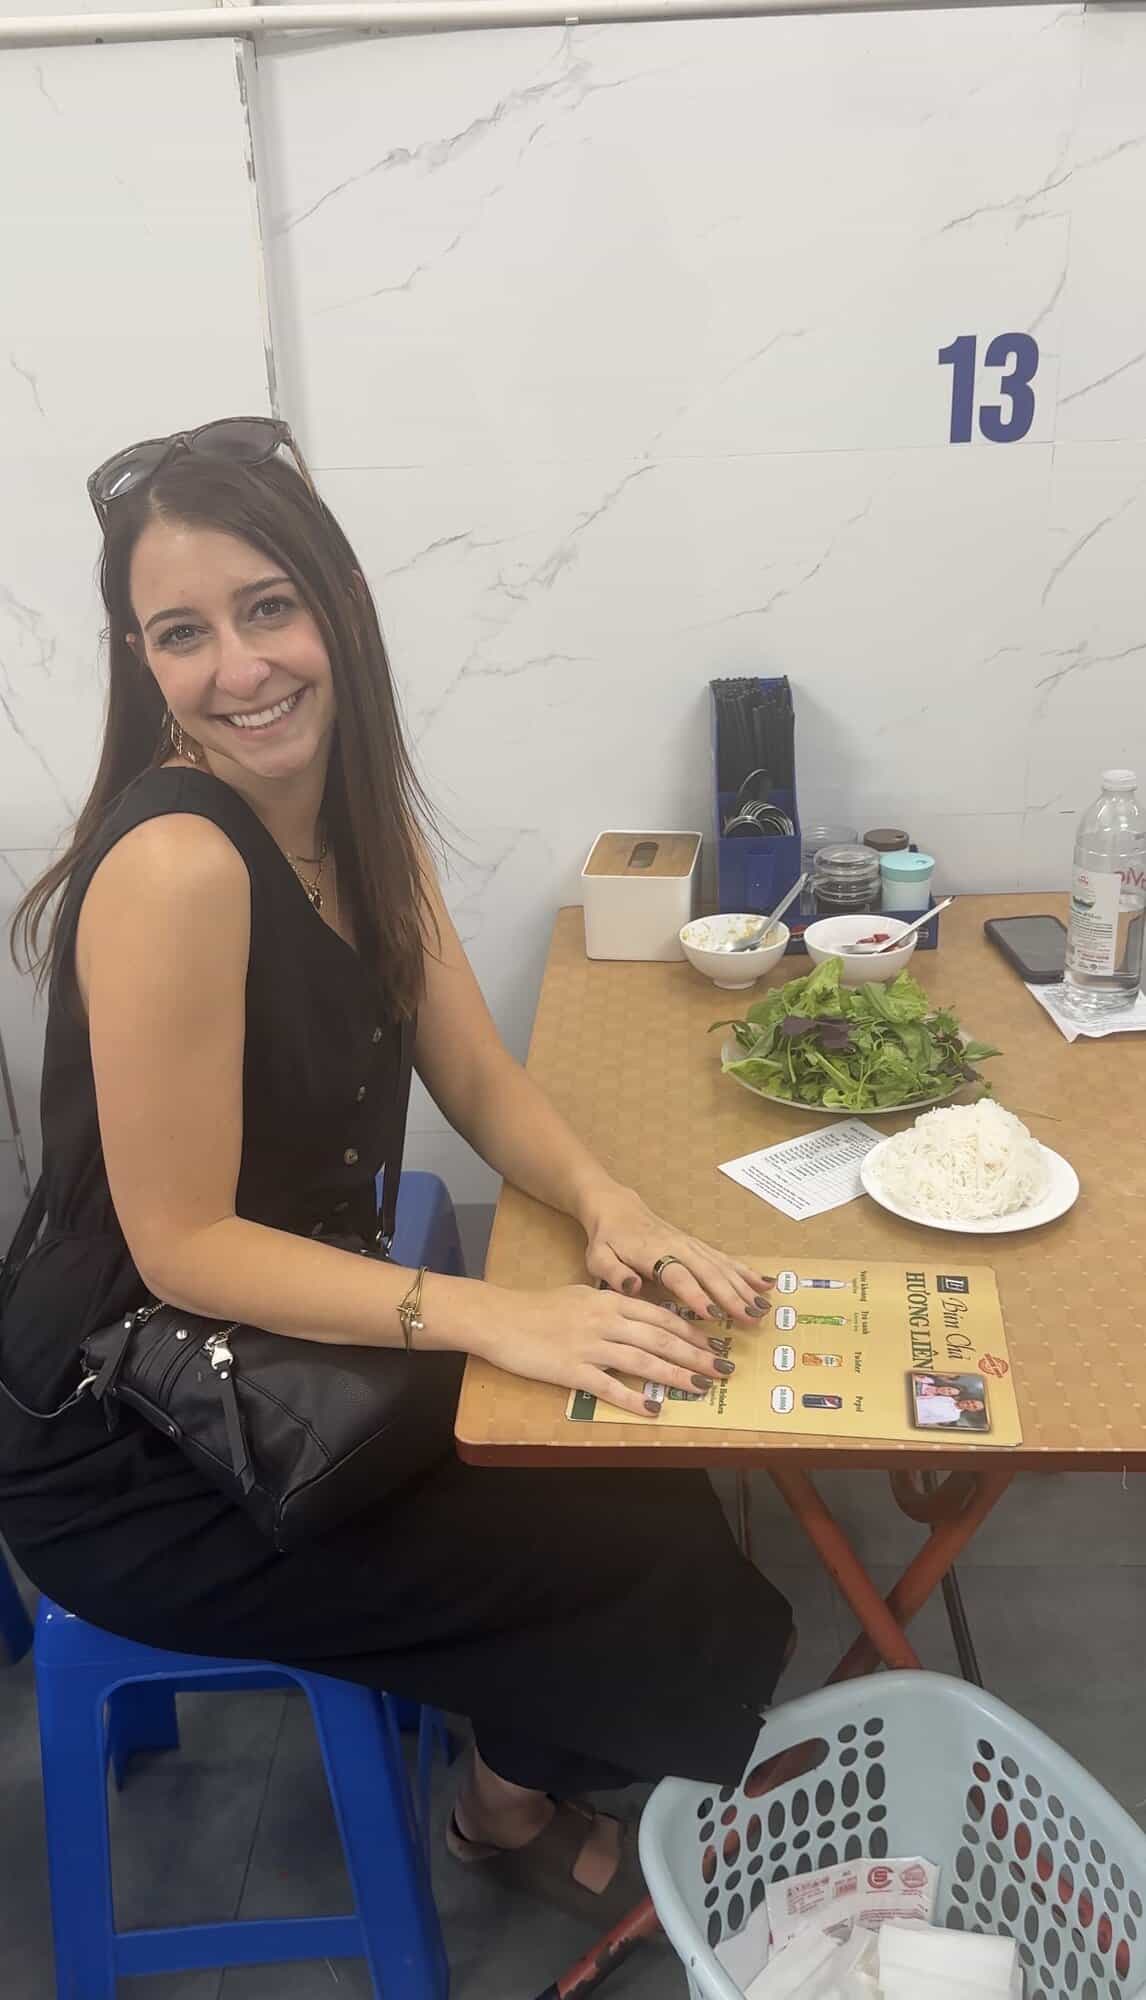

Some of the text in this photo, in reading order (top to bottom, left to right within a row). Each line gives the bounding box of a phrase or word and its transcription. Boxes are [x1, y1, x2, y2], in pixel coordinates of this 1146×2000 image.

[938, 332, 1039, 443] 13
[906, 1271, 939, 1370] HƯƠNG LIÊN
